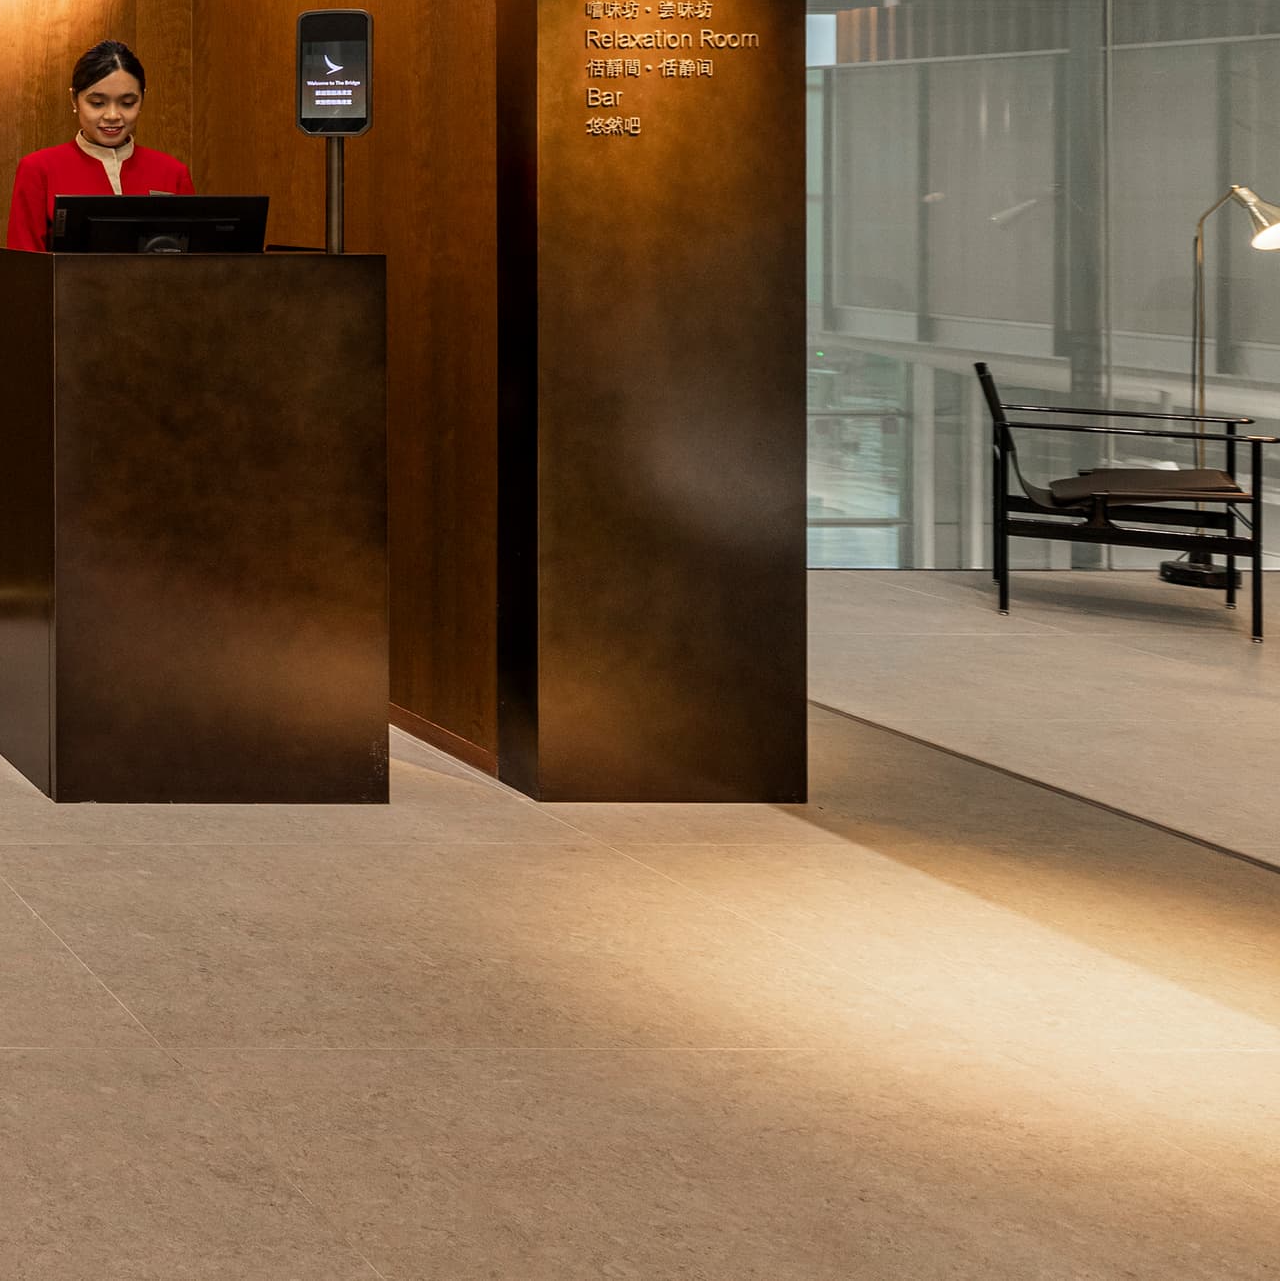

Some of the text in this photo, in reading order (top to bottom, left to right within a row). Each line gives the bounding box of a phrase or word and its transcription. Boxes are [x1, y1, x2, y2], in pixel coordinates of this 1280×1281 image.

[585, 29, 760, 49] Relaxation Room
[586, 87, 623, 107] Bar
[586, 115, 642, 136] 悠然吧
